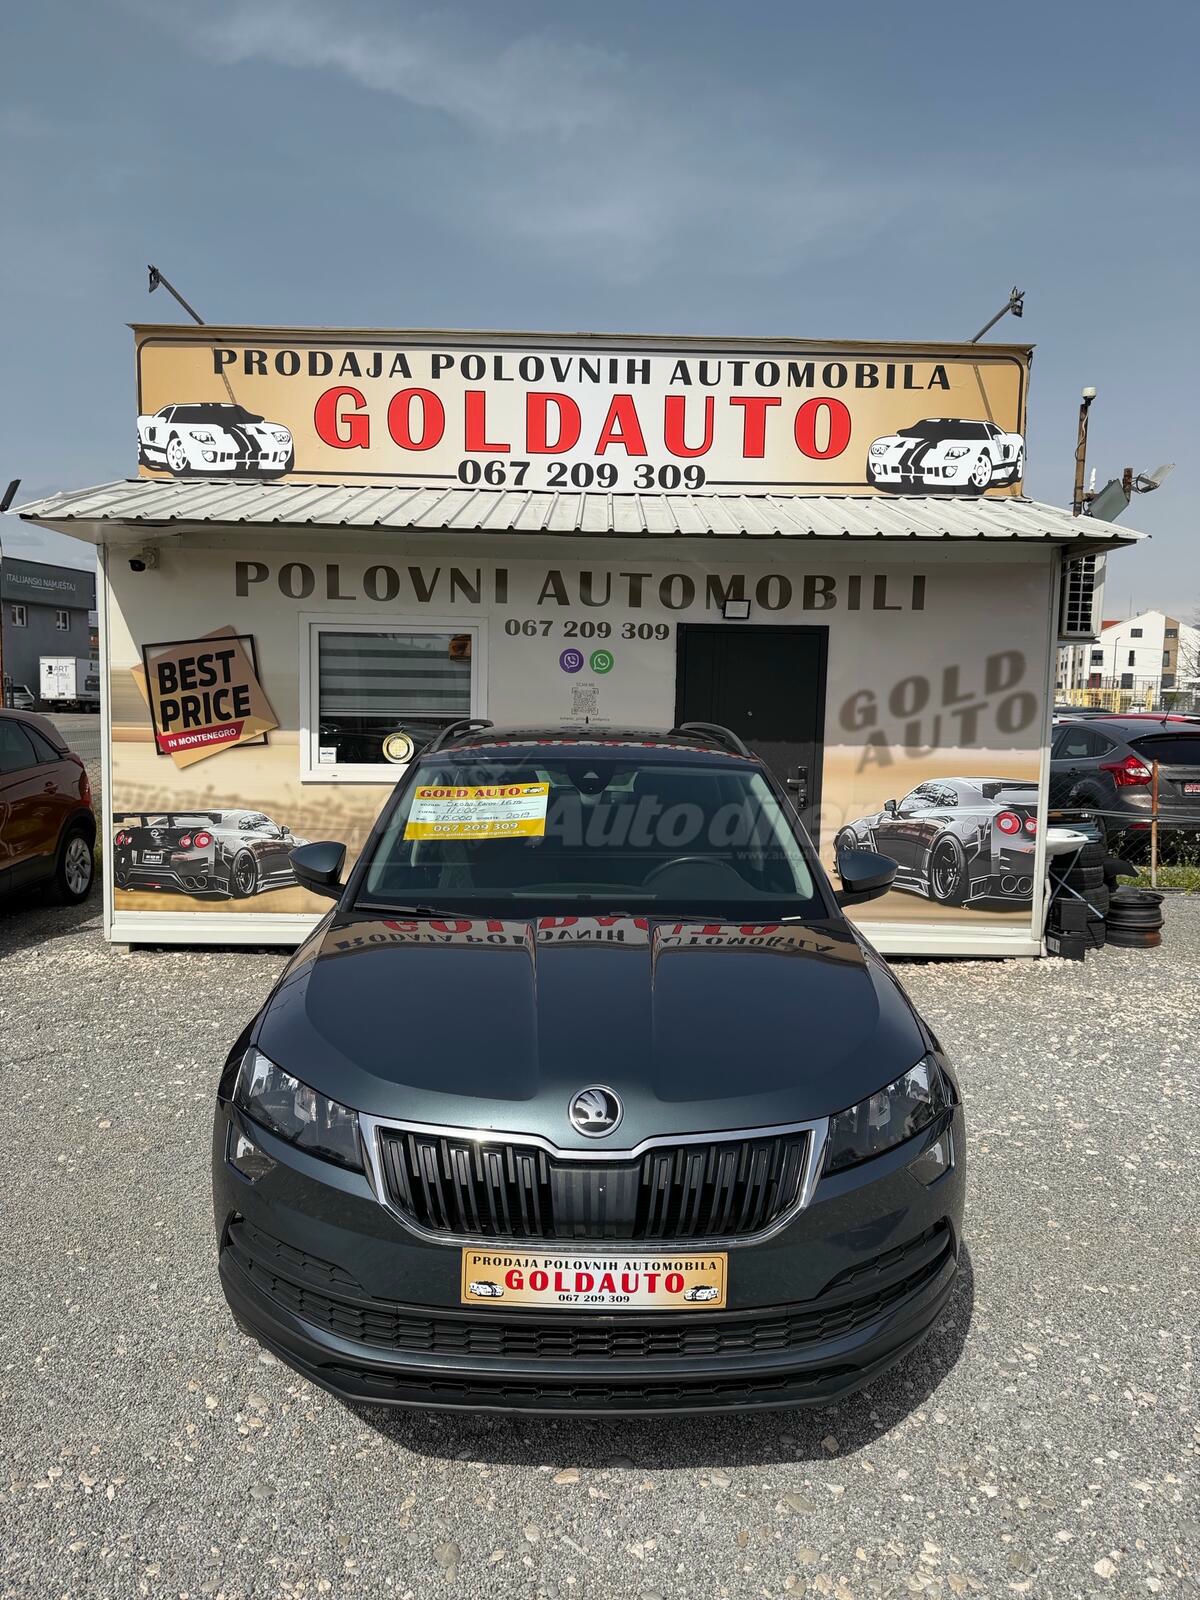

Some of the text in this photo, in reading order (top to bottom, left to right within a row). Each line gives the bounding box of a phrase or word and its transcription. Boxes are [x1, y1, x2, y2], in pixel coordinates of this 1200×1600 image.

[213, 348, 951, 391] PRODAJA POLOVNIH AUTOMOBILA
[313, 385, 852, 461] GOLDAUTO
[457, 459, 707, 491] 067 209 309
[235, 560, 927, 611] POLOVNI AUTOMOBILI
[504, 618, 670, 641] 067 209 309
[157, 649, 235, 695] BEST
[838, 649, 1027, 733] GOLD
[160, 684, 251, 732] PRICE
[168, 728, 237, 748] IN MONTENEGRO
[856, 690, 1038, 773] AUTO
[420, 787, 521, 798] GOLD AUTO
[494, 822, 518, 830] 309
[472, 1256, 717, 1271] PRODAJA POLOVNIH AUTOMOBILA
[504, 1268, 685, 1294] GOLDAUTO
[558, 1294, 630, 1303] 067 209 309
